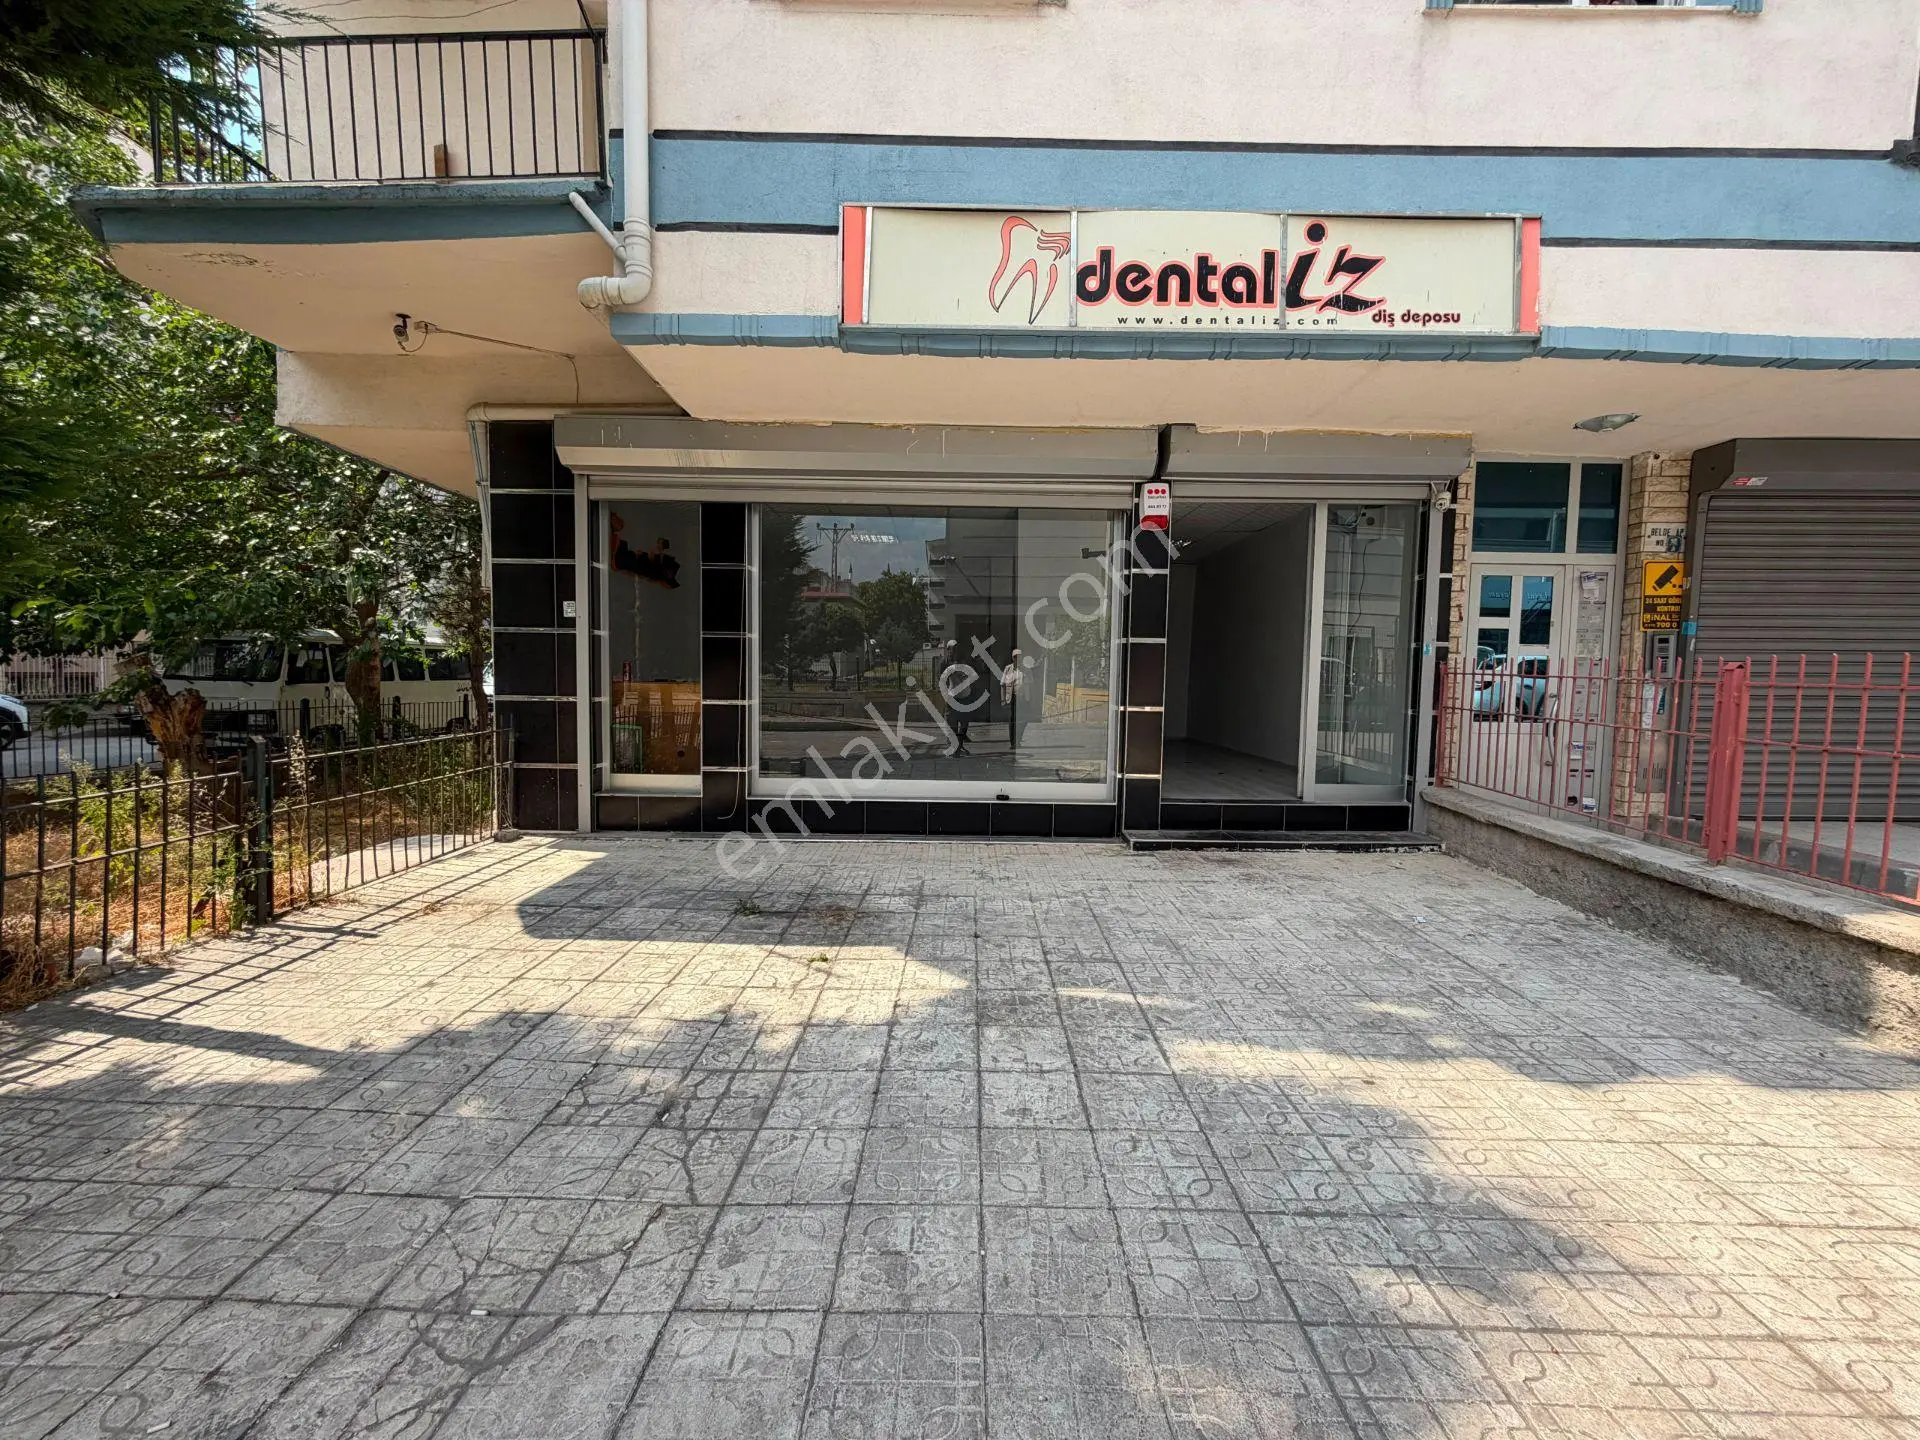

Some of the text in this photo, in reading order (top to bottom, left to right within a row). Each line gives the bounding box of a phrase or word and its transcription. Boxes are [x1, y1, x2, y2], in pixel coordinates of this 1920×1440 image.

[1117, 314, 1338, 326] www.dentaliz.com
[1371, 309, 1462, 327] diş deposu
